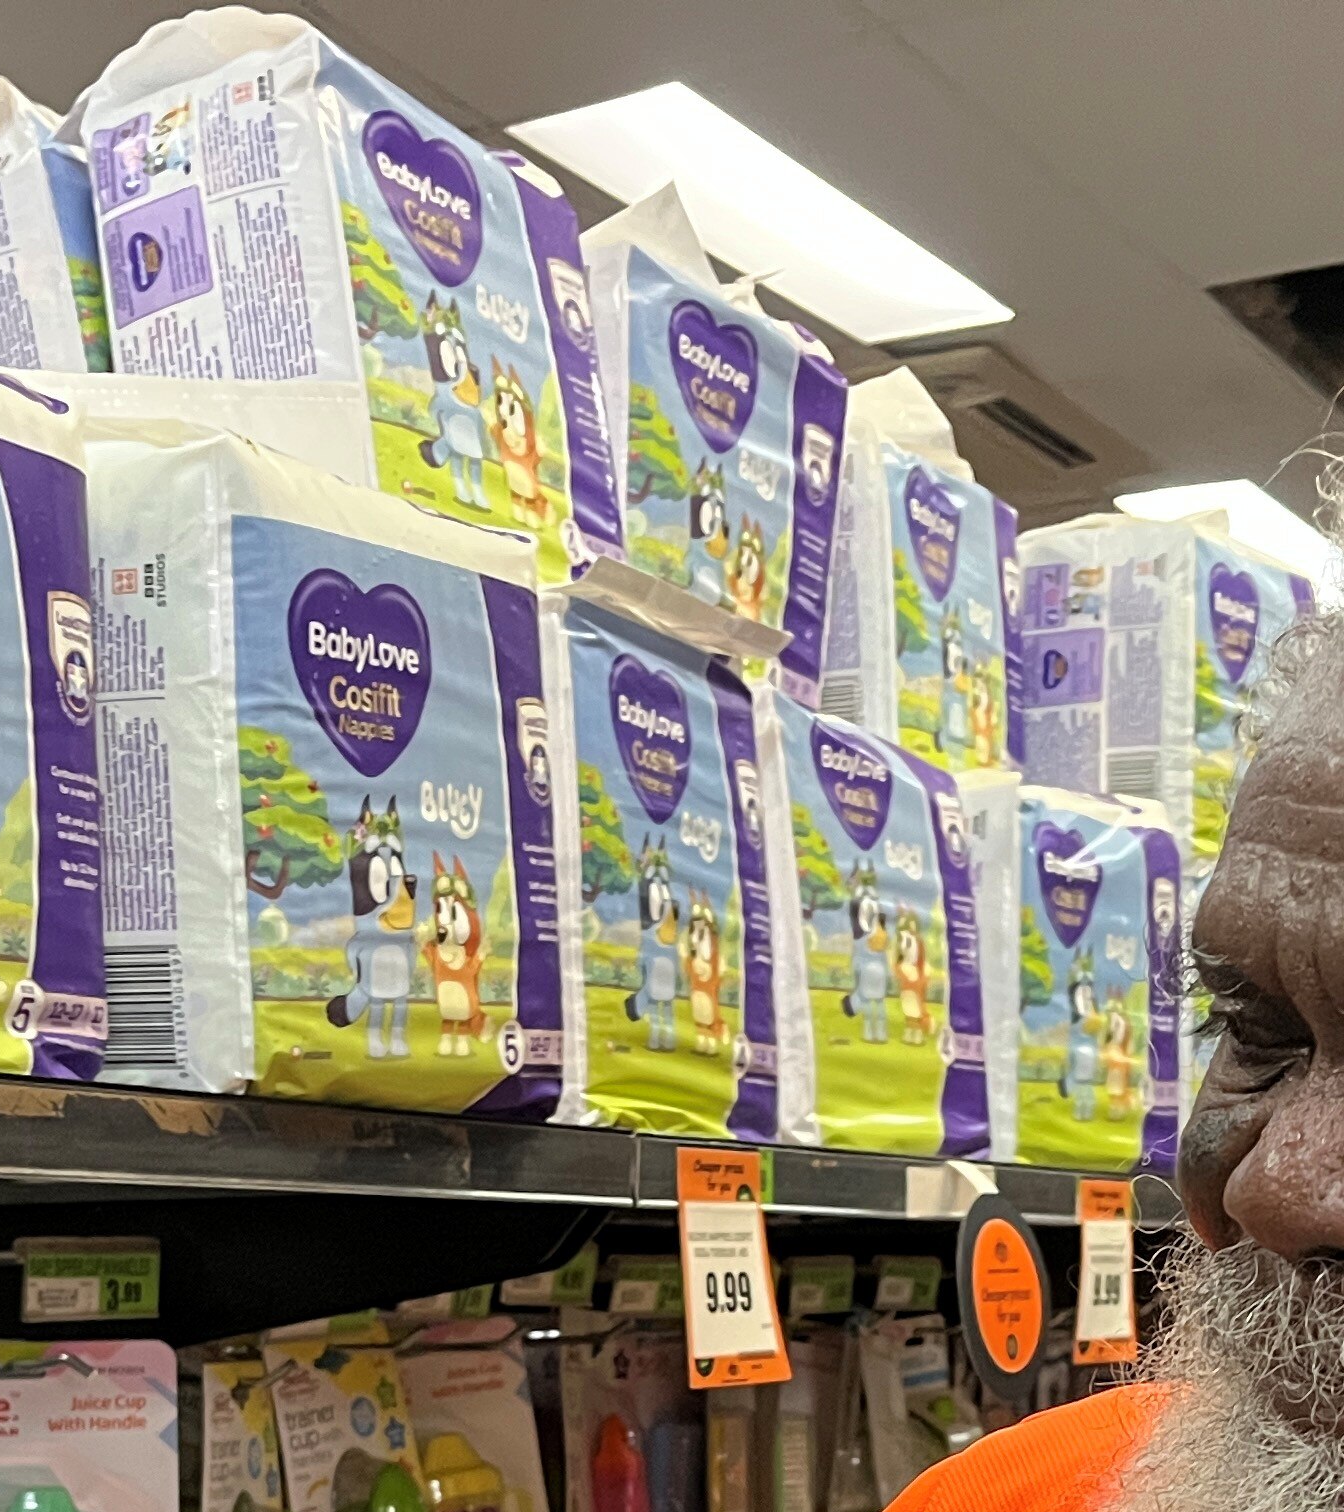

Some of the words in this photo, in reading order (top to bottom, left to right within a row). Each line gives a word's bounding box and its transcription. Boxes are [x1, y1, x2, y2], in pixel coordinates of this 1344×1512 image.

[307, 620, 420, 674] BabyLove
[329, 674, 402, 719] Cosifit
[11, 996, 35, 1034] 5
[505, 1033, 518, 1065] 5
[706, 1271, 753, 1314] 9.99
[71, 1395, 113, 1412] Juice
[114, 1394, 147, 1412] Cup
[90, 1415, 148, 1432] Handle
